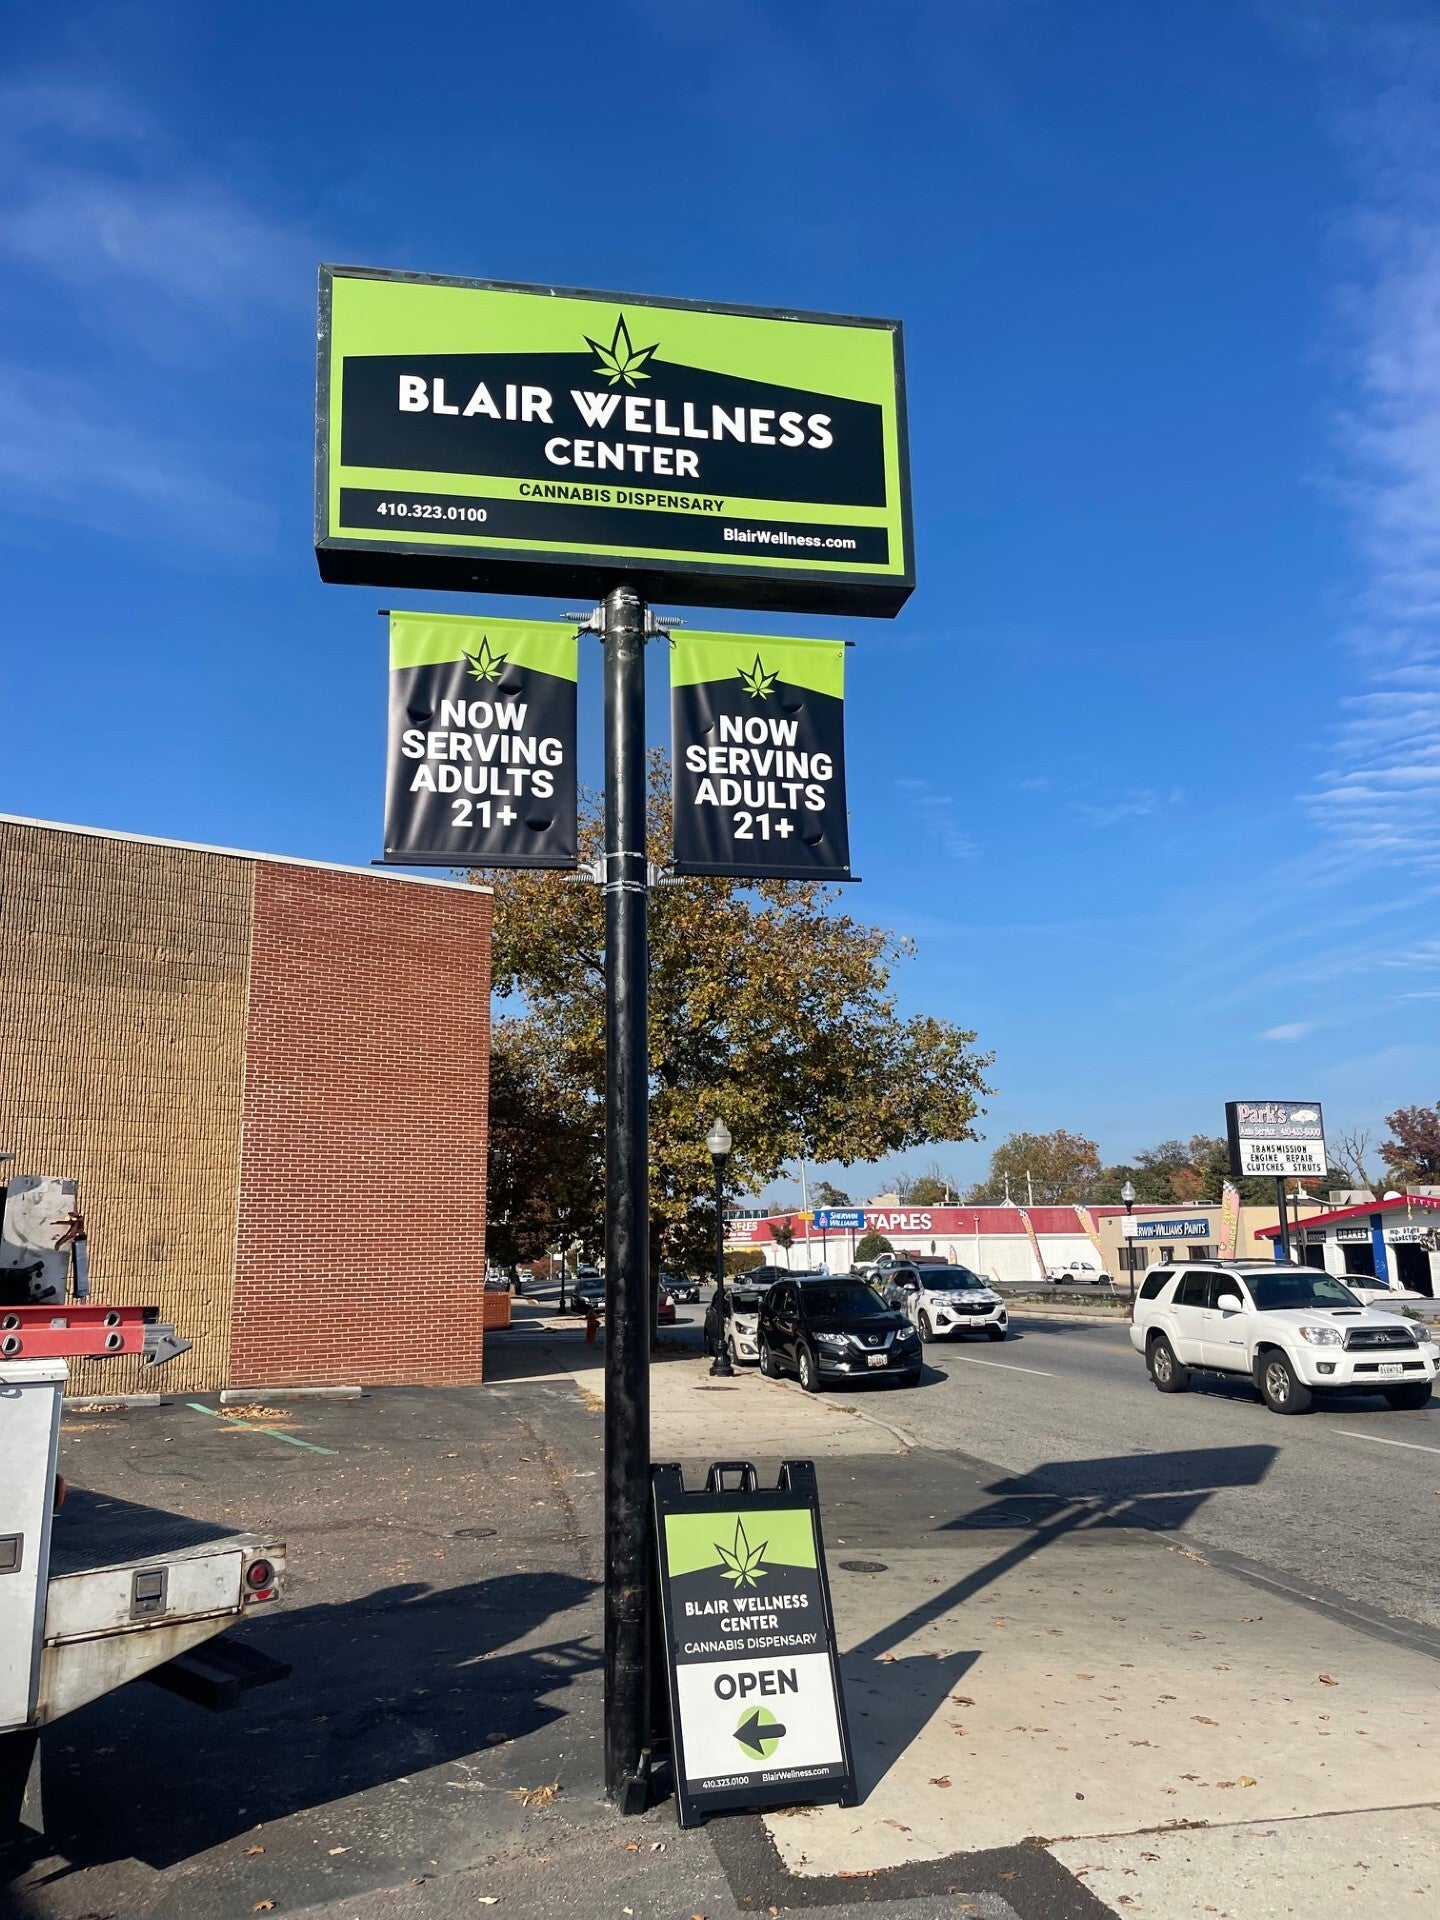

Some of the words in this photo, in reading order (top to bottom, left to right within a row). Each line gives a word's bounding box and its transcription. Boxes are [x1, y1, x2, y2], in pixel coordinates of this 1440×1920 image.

[398, 374, 554, 424] BLAIR
[570, 389, 834, 449] WELLNESS
[544, 437, 700, 478] CENTER
[519, 483, 611, 503] CANNABIS
[616, 490, 725, 512] DISPENSARY
[376, 502, 488, 523] 410.323.0100
[723, 528, 857, 549] BlairWellness.com
[439, 699, 528, 731] NOW
[719, 714, 799, 747] NOW
[401, 729, 563, 766] SERVING
[685, 744, 833, 781] SERVING
[409, 763, 554, 799] ADULTS
[693, 777, 826, 812] ADULTS
[451, 798, 518, 829] 21+
[732, 811, 794, 841] 21+
[1237, 1104, 1287, 1124] Park's
[1250, 1154, 1278, 1162] ENGINE
[1286, 1154, 1313, 1163] REPAIR
[1251, 1144, 1307, 1153] TRANSMISSION
[1246, 1163, 1285, 1172] CLUTCHES
[1293, 1163, 1321, 1172] STRUTS
[829, 1211, 859, 1220] SHERWIN
[1183, 1222, 1206, 1235] PAINTS
[1338, 1229, 1367, 1240] BRAKES
[685, 1599, 730, 1617] BLAIR
[732, 1593, 809, 1613] WELLNESS
[720, 1614, 779, 1633] CENTER
[684, 1638, 745, 1654] CANNABIS
[746, 1632, 818, 1649] DISPENSARY
[714, 1668, 799, 1701] OPEN
[702, 1775, 750, 1789] 410.323.0100
[762, 1767, 830, 1782] BlairWellness.com
